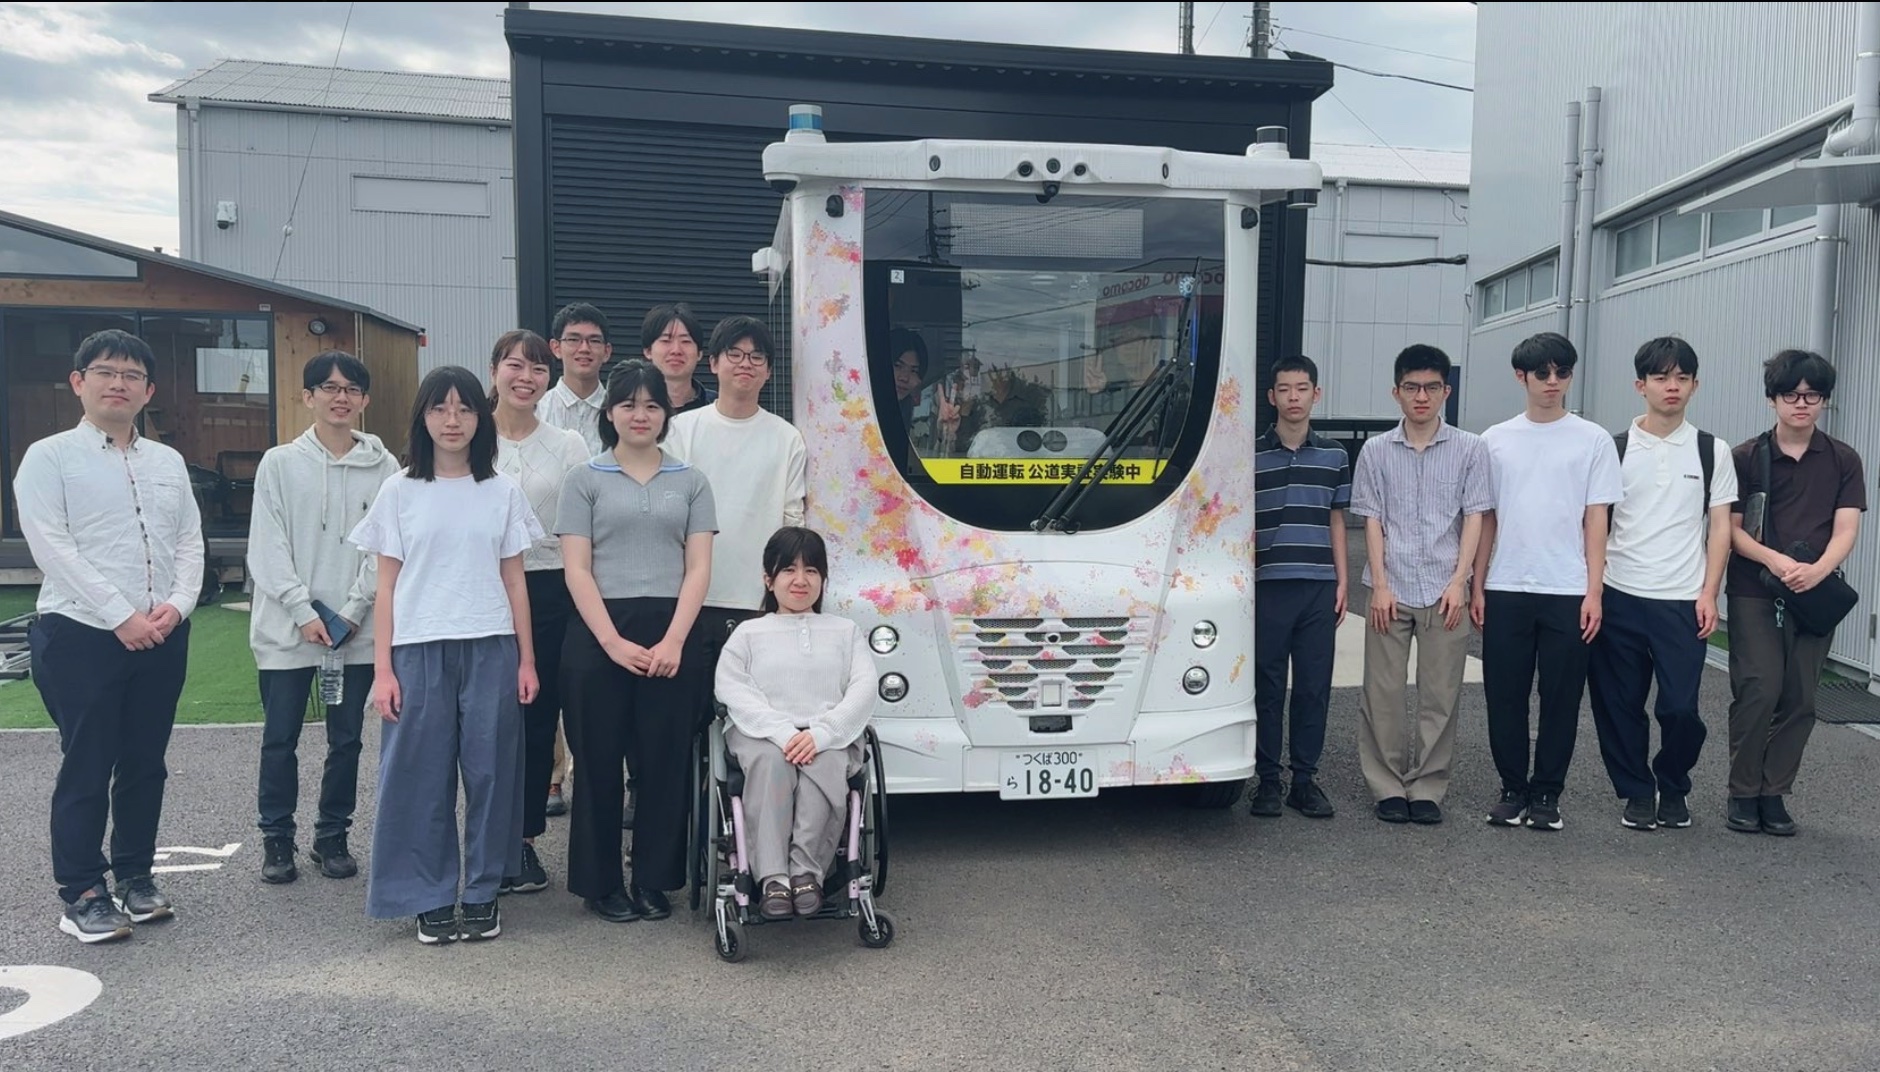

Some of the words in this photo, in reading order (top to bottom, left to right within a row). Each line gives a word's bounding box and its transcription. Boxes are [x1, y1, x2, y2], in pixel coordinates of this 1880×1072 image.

[960, 463, 1025, 480] 自動運転
[1007, 775, 1018, 789] ら
[1026, 767, 1093, 795] 18-40
